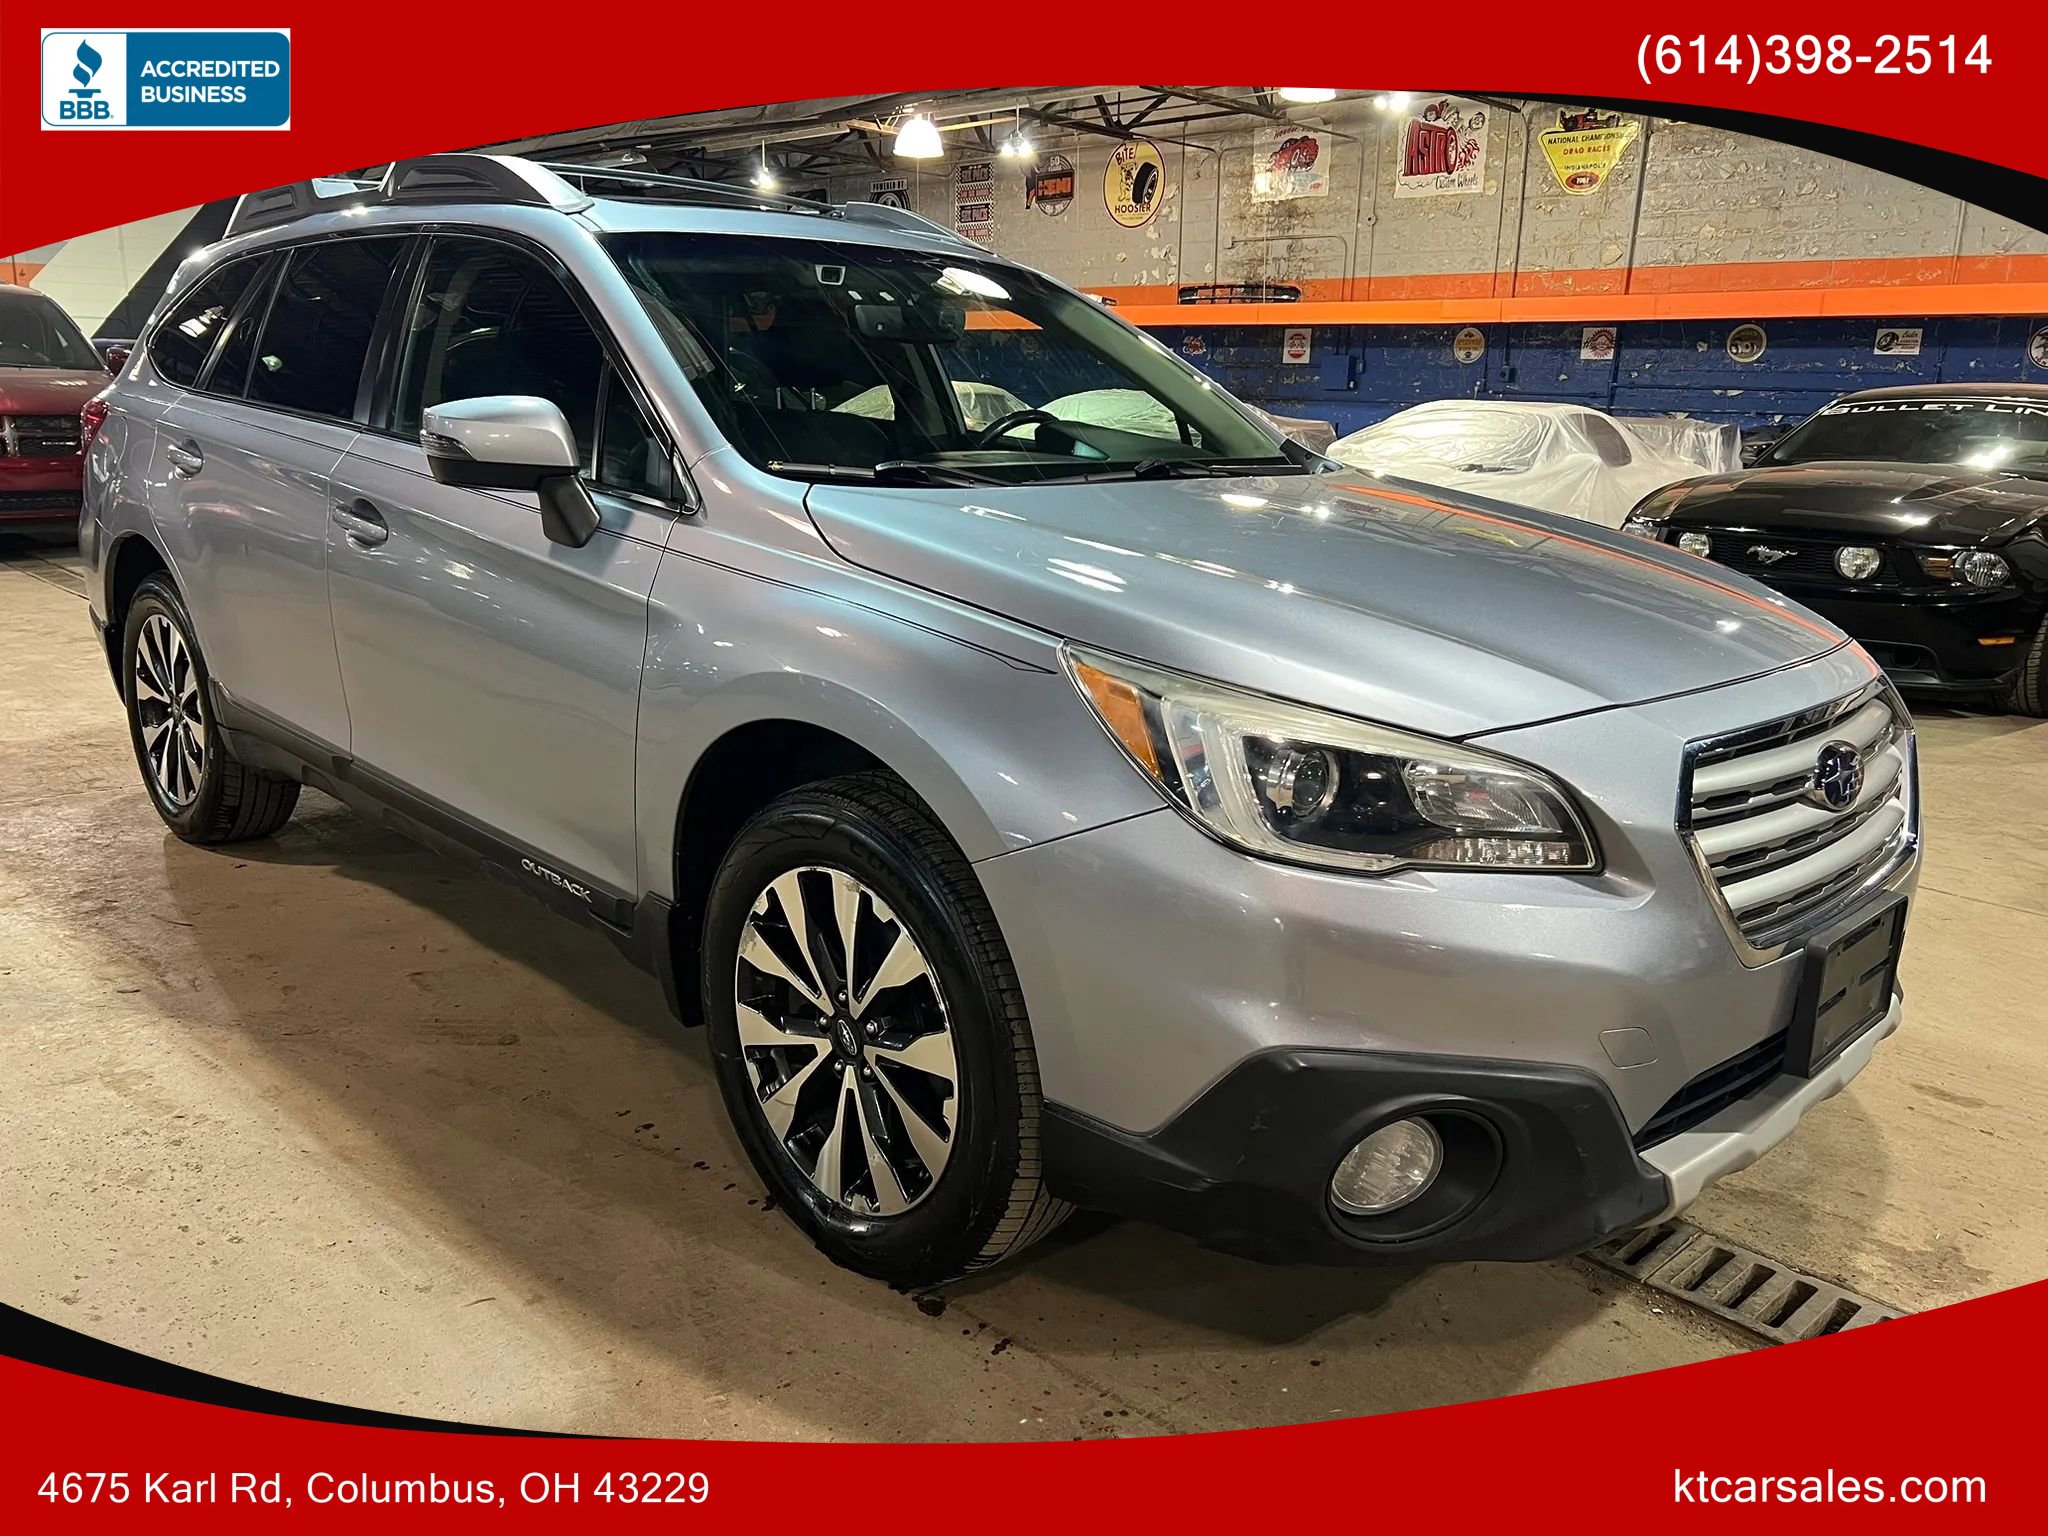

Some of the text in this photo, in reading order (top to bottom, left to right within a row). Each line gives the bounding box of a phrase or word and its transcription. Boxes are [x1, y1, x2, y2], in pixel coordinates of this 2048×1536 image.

[1547, 135, 1579, 145] NATIONAL
[1403, 118, 1458, 176] ASTRO
[1563, 144, 1611, 156] DRAG RACES
[1037, 177, 1072, 196] HEMI
[1114, 203, 1151, 214] HOOSIER
[1821, 404, 1974, 416] BULLET
[521, 858, 592, 903] OUTBACK
